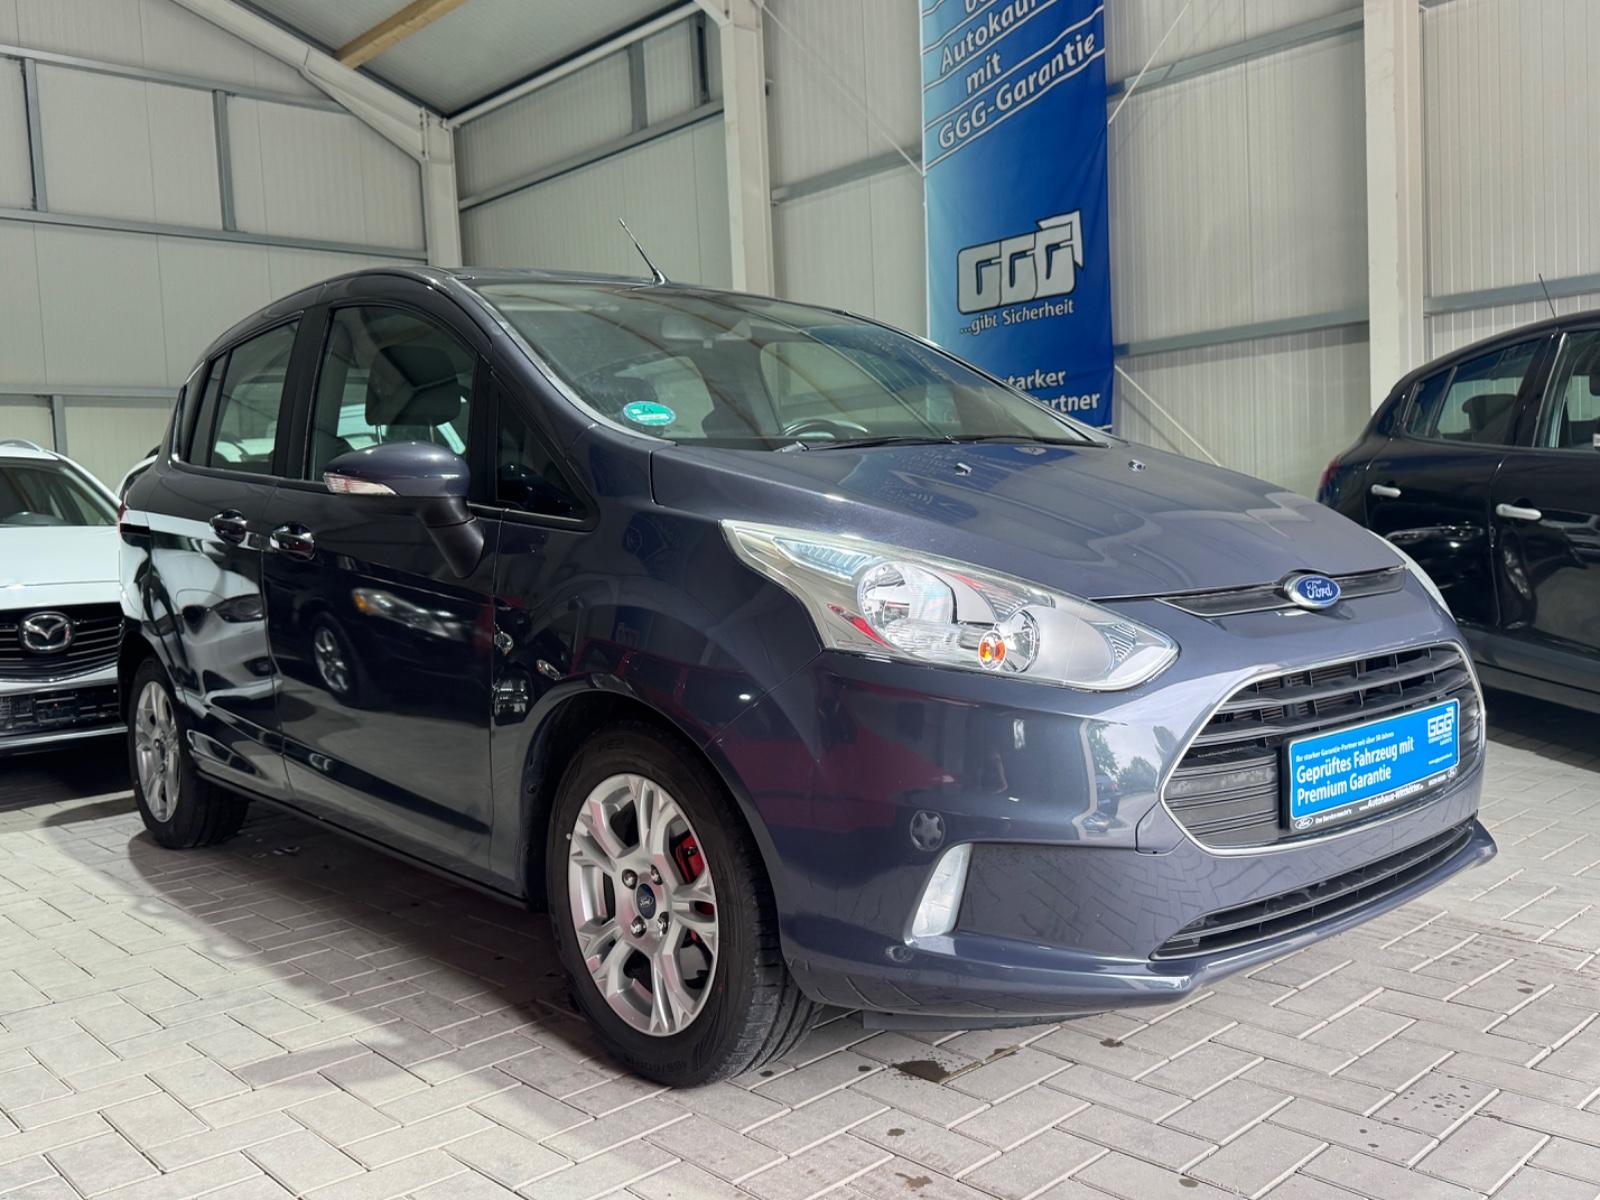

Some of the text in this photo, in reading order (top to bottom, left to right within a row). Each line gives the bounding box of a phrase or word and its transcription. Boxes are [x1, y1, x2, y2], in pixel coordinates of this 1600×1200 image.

[938, 33, 1095, 149] GGG-Garantie
[966, 52, 1001, 94] mit
[958, 211, 1083, 314] GGG
[1002, 299, 1074, 326] Sicherheit
[1003, 369, 1066, 390] tarker
[1305, 580, 1333, 599] Ford
[1296, 757, 1351, 784] Geprüftes
[1354, 741, 1398, 768] Fahrzeug
[1399, 736, 1414, 753] mit
[1297, 780, 1347, 807] Premium
[1350, 764, 1392, 790] Garantie
